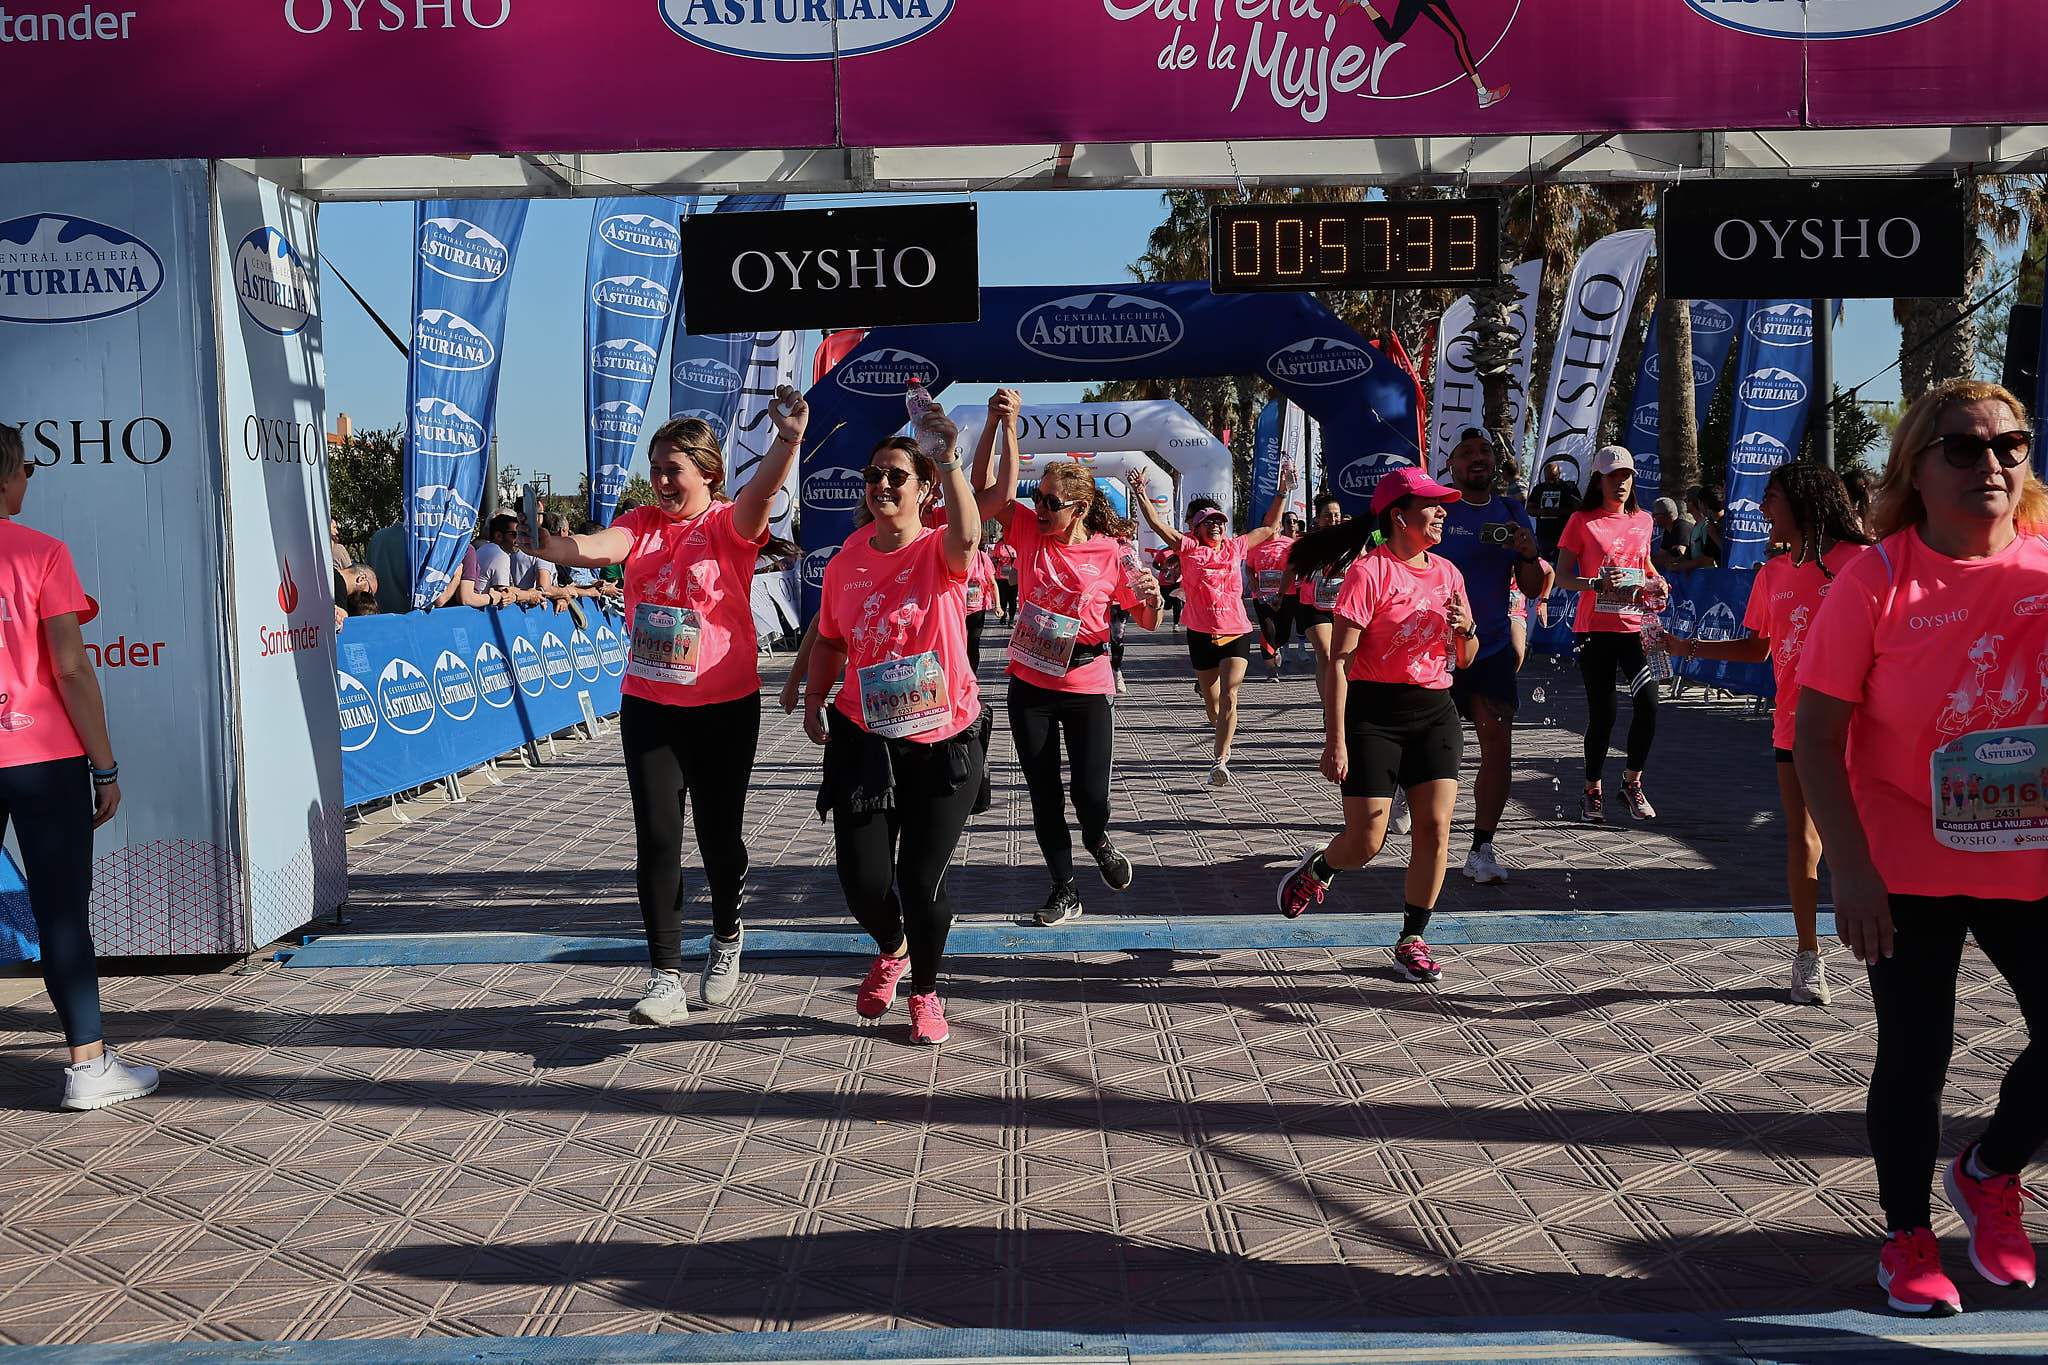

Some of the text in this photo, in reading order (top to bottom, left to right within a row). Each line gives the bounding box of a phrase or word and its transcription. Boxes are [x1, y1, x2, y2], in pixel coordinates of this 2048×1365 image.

[0, 6, 136, 42] tander
[1157, 14, 1407, 123] de la Mujer
[605, 222, 677, 252] ASTURIANA
[1233, 215, 1477, 276] 00:57:33
[1713, 216, 1922, 262] OYSHO
[0, 250, 138, 264] ENTRAL LECHERA
[420, 231, 502, 275] ASTURIANA
[0, 266, 148, 296] TURIANA
[732, 246, 936, 293] OYSHO
[242, 257, 308, 314] ASTURIANA
[597, 285, 667, 314] ASTURIAN
[1055, 311, 1166, 322] CENTRAL LECHERA
[1753, 316, 1813, 337] ASTURIAN
[1029, 316, 1172, 345] ASTURIANA
[594, 351, 655, 375] ASTURIAN
[1276, 357, 1367, 376] ASTURIANA
[678, 366, 737, 389] ASTURIANA
[244, 414, 318, 466] OYSHO
[1169, 437, 1208, 448] OYSHO
[1190, 491, 1227, 501] OYSHO
[843, 580, 873, 591] OYSHO
[1909, 608, 1969, 630] OYSHO
[259, 620, 321, 657] Santander
[438, 678, 476, 705] ASTURIANA
[888, 690, 921, 707] 016
[383, 690, 434, 719] ASTURIANA
[1979, 747, 2034, 760] ASTURIANA
[1982, 783, 2040, 805] 016
[1942, 822, 1979, 831] CARRERA
[2004, 819, 2032, 828] MUJER
[1995, 808, 2021, 818] 2431
[1950, 835, 1997, 846] OYSHO
